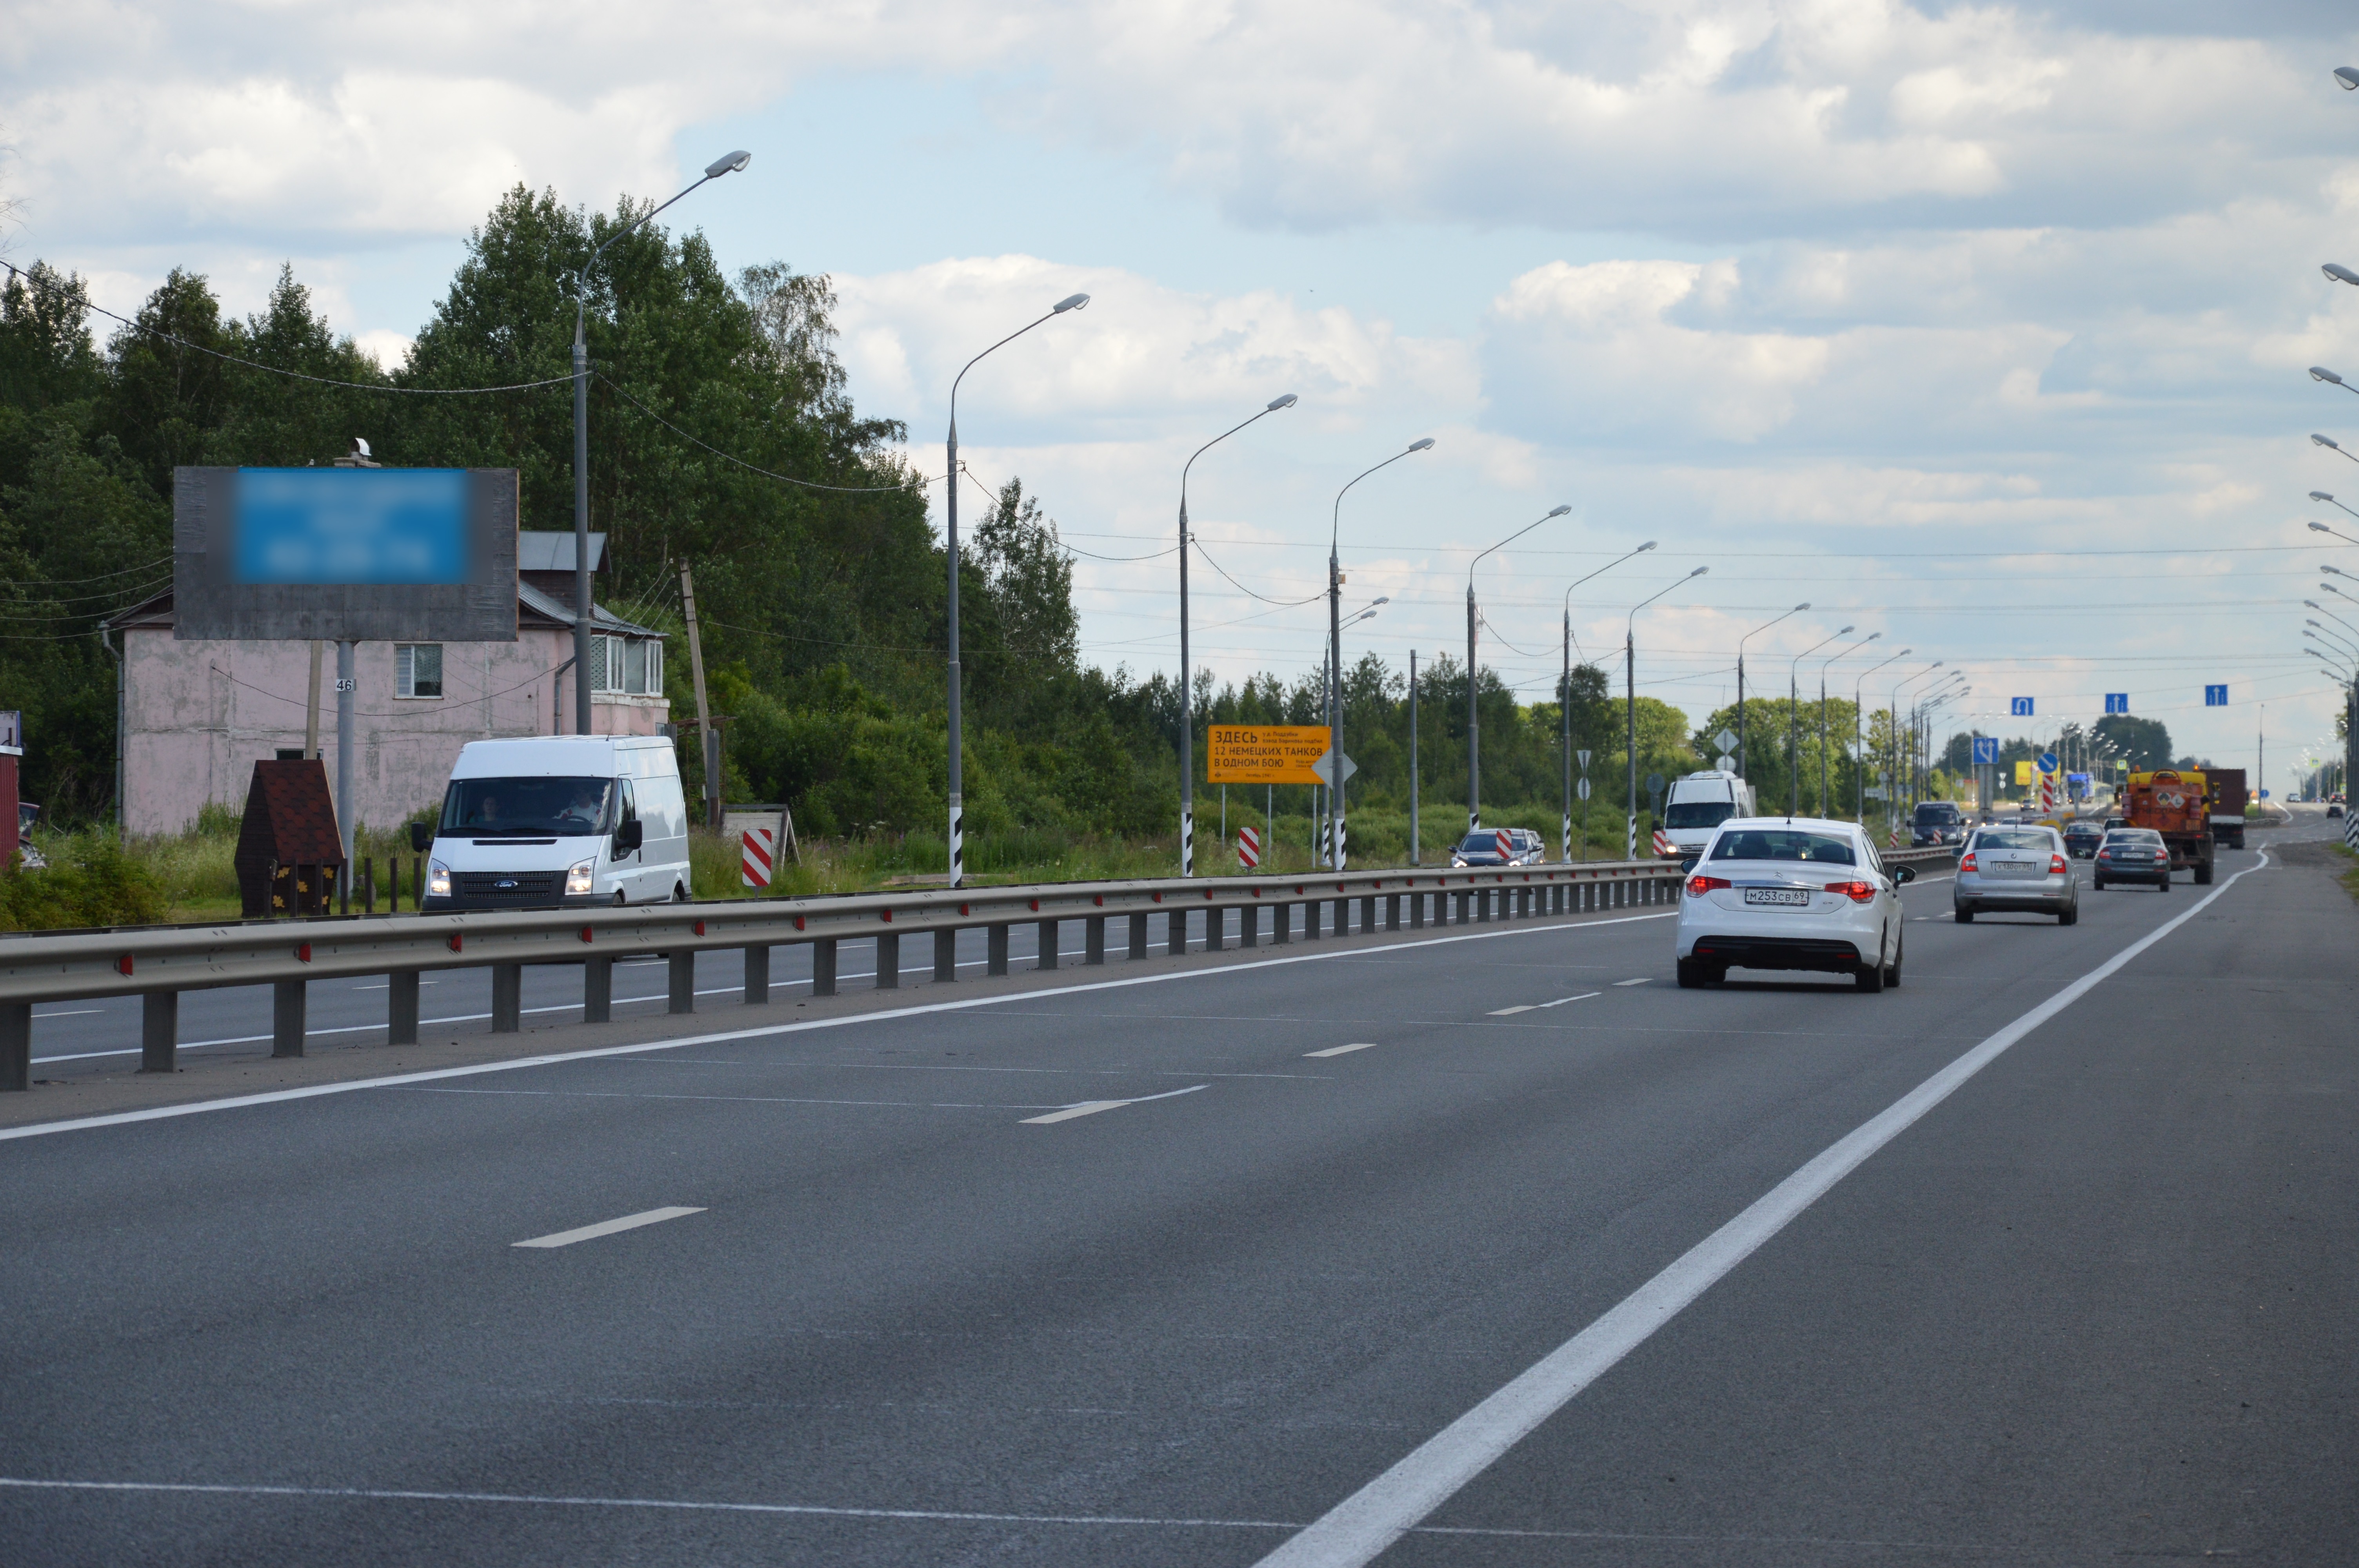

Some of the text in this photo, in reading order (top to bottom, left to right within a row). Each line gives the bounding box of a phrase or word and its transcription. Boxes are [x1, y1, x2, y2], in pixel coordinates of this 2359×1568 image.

[336, 680, 352, 691] 46
[1215, 731, 1258, 744] ЗДЕСЬ
[1215, 747, 1323, 756] 12 НЕМЕЦКИХ ТАНКОВ
[1223, 759, 1259, 768] ОДНОМ
[1262, 759, 1284, 767] БОЮ
[1750, 891, 1791, 901] М253СВ
